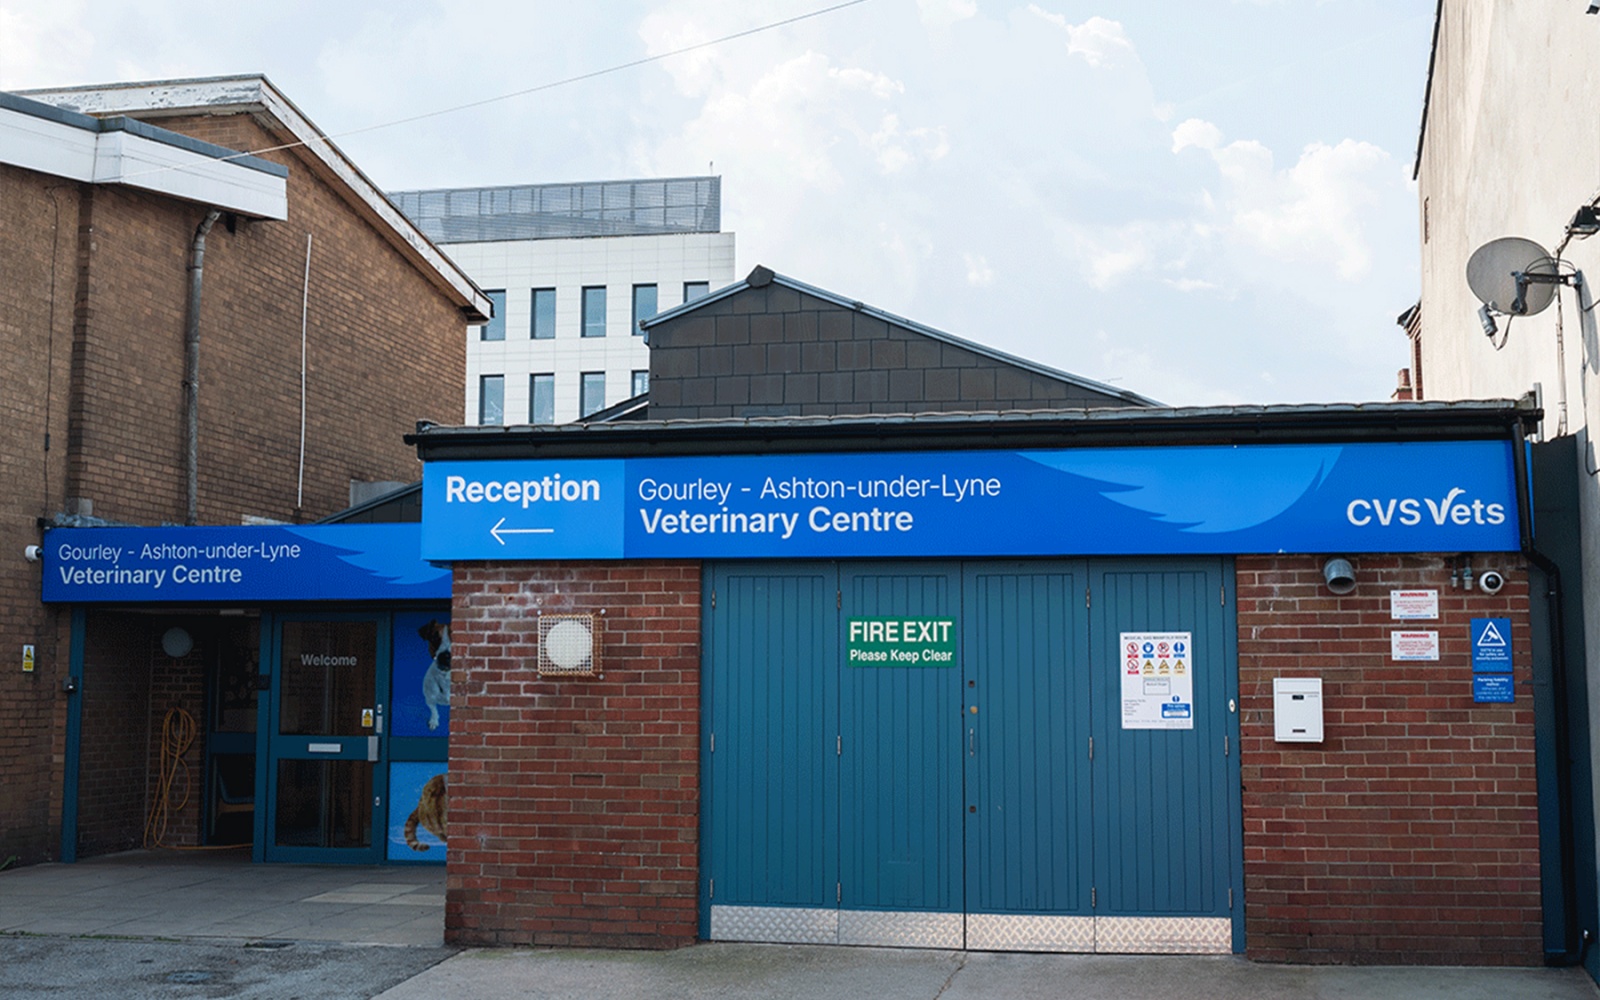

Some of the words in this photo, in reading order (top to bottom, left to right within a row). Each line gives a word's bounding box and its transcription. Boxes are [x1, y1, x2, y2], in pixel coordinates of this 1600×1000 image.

[446, 473, 600, 509] Reception
[638, 477, 732, 505] Gourley
[760, 474, 1001, 503] Ashton-under-Lyne
[639, 506, 799, 539] Veterinary
[808, 505, 913, 533] Centre
[58, 544, 122, 563] Gourley
[140, 542, 301, 562] Ashton-under-Lyne
[59, 565, 166, 588] Veterinary
[172, 564, 242, 584] Centre
[850, 621, 900, 642] FIRE
[903, 621, 953, 642] EXIT
[300, 653, 357, 666] Welcome
[850, 648, 888, 661] Please
[890, 648, 919, 664] Keep
[922, 648, 953, 661] Clear
